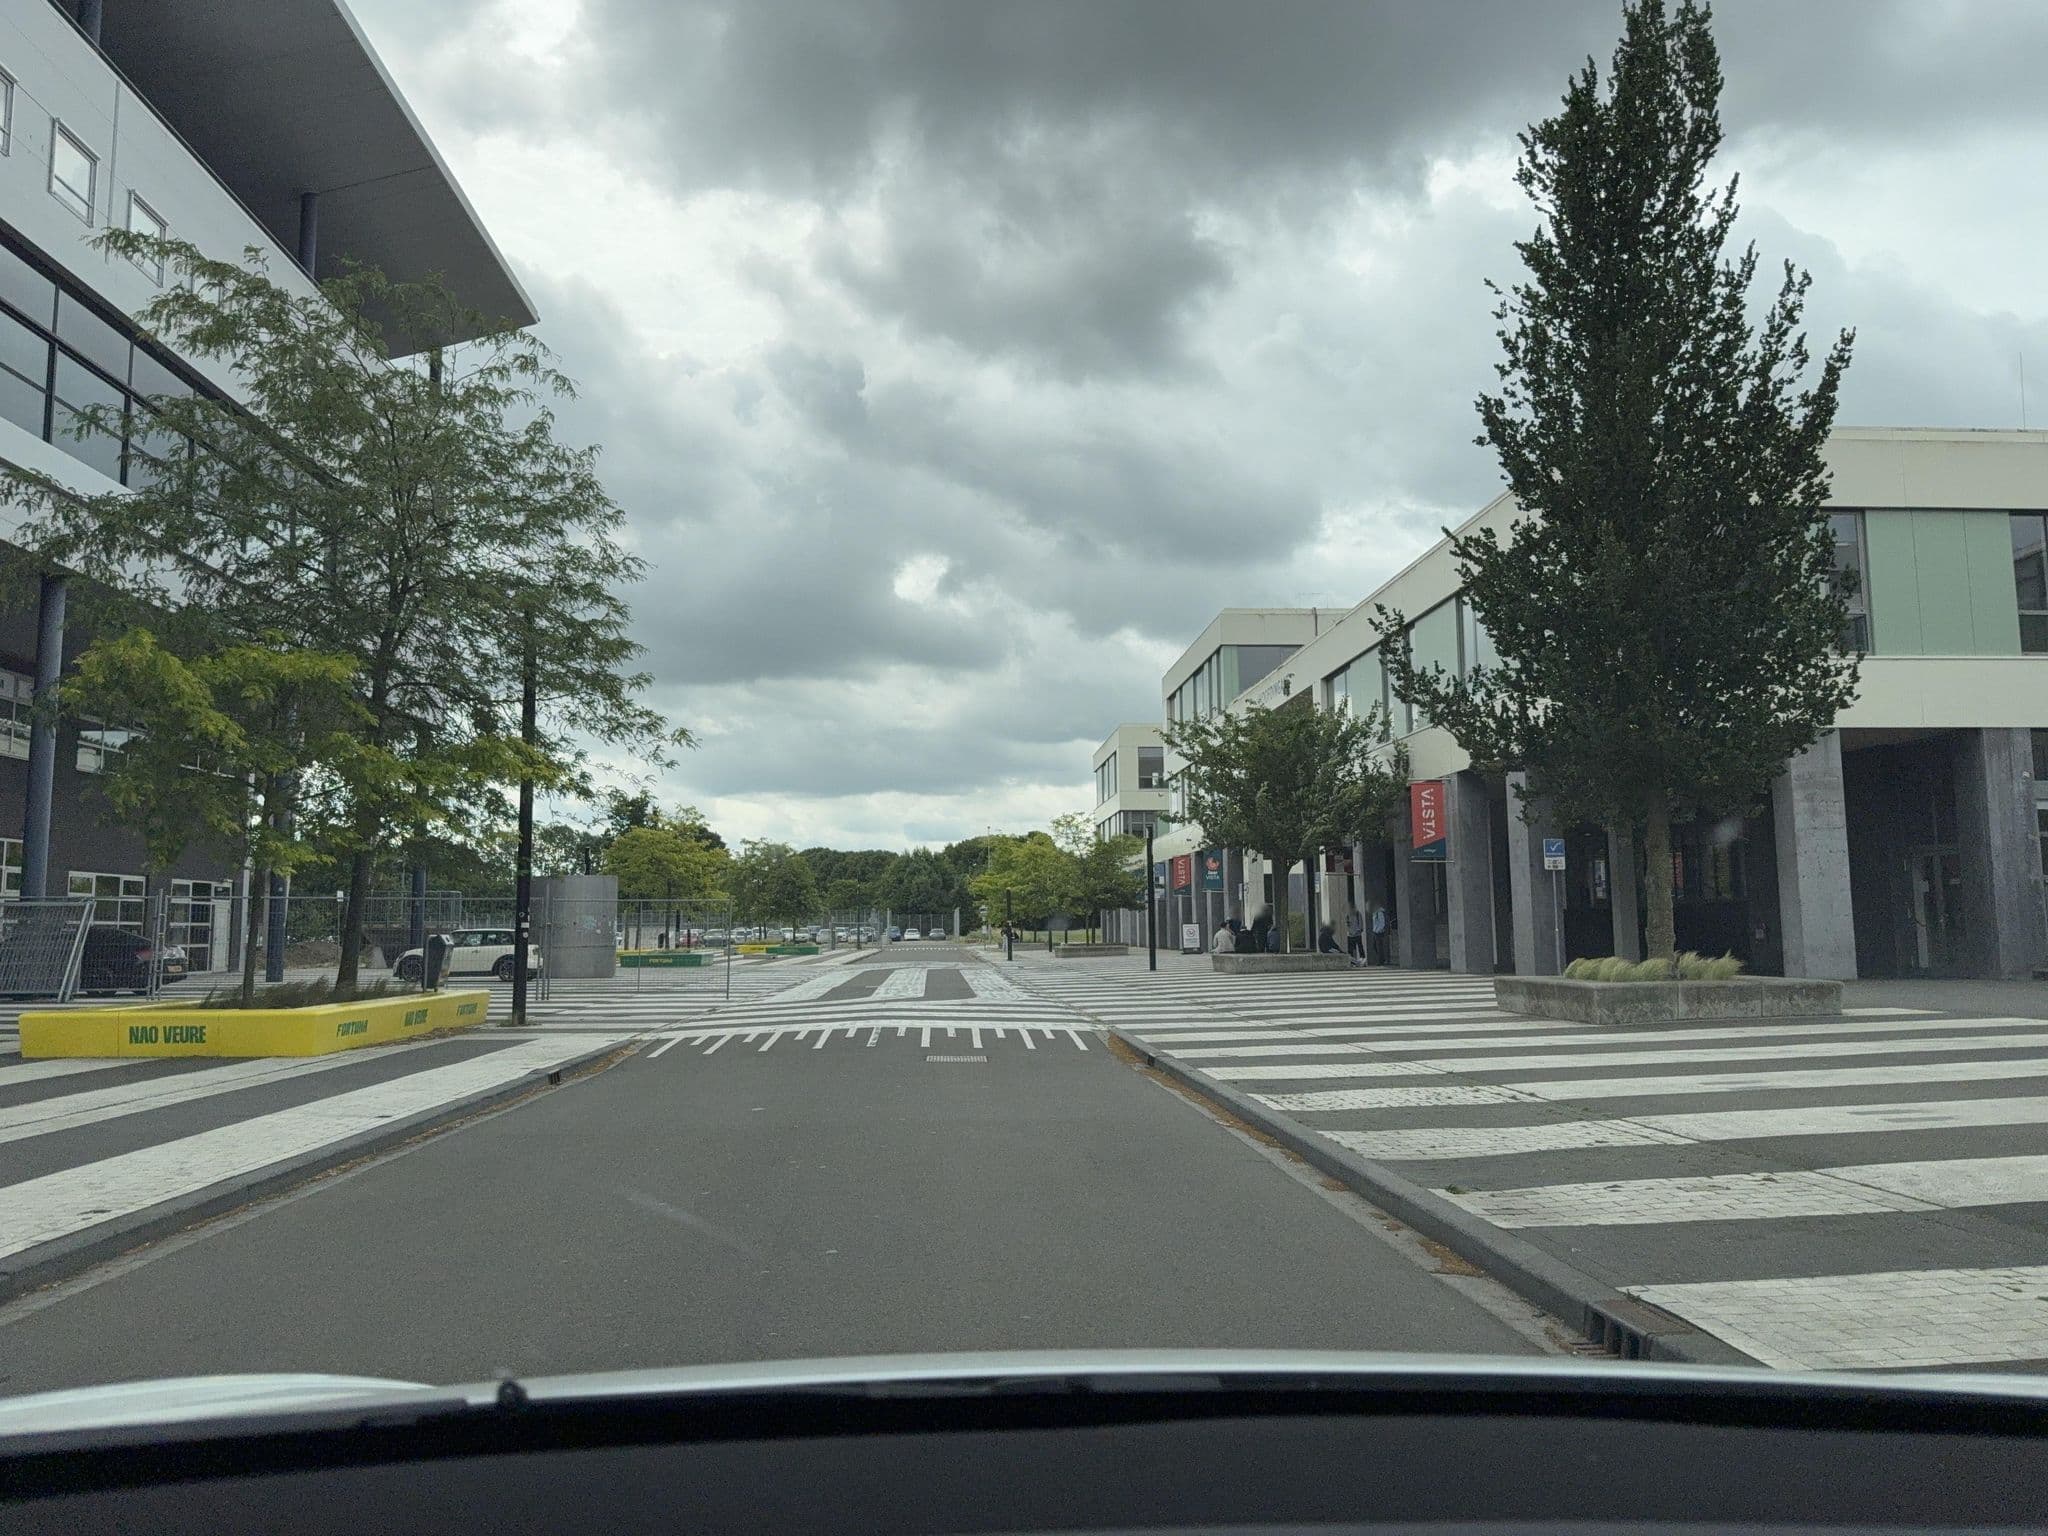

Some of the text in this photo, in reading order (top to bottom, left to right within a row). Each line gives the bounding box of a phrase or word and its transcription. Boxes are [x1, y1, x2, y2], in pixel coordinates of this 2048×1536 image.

[1421, 788, 1436, 839] VISTA
[1177, 859, 1186, 886] VISTA
[128, 1025, 207, 1044] NAO VEURE
[336, 1019, 369, 1037] FORTUNA
